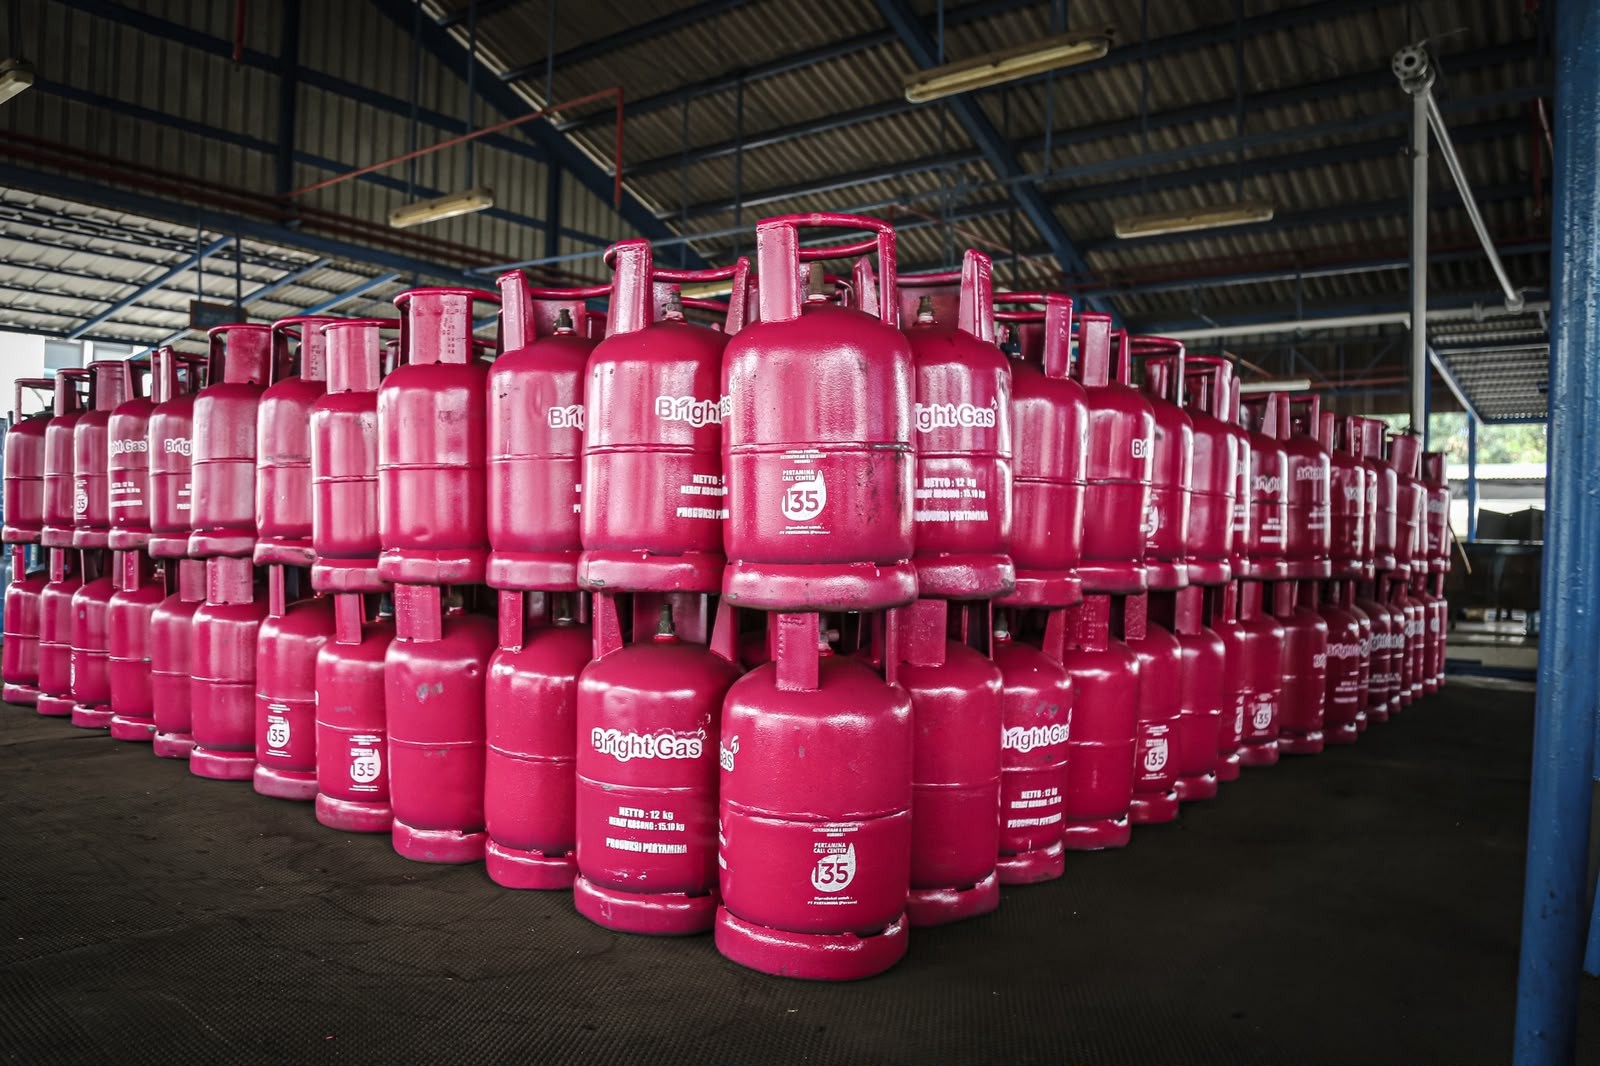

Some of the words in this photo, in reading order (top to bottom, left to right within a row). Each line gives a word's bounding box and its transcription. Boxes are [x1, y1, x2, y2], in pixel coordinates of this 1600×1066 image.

[164, 438, 192, 456] Brig
[693, 474, 717, 485] NETTO
[784, 490, 819, 513] 135
[268, 728, 286, 743] 135
[1002, 726, 1050, 753] right
[1146, 752, 1165, 766] 135
[352, 762, 376, 777] 135
[618, 806, 644, 819] NETTO
[649, 810, 660, 820] 12
[662, 810, 674, 821] kg
[605, 837, 642, 853] PRODUKSI
[642, 842, 688, 854] PERTAMINA
[814, 862, 849, 885] 135
